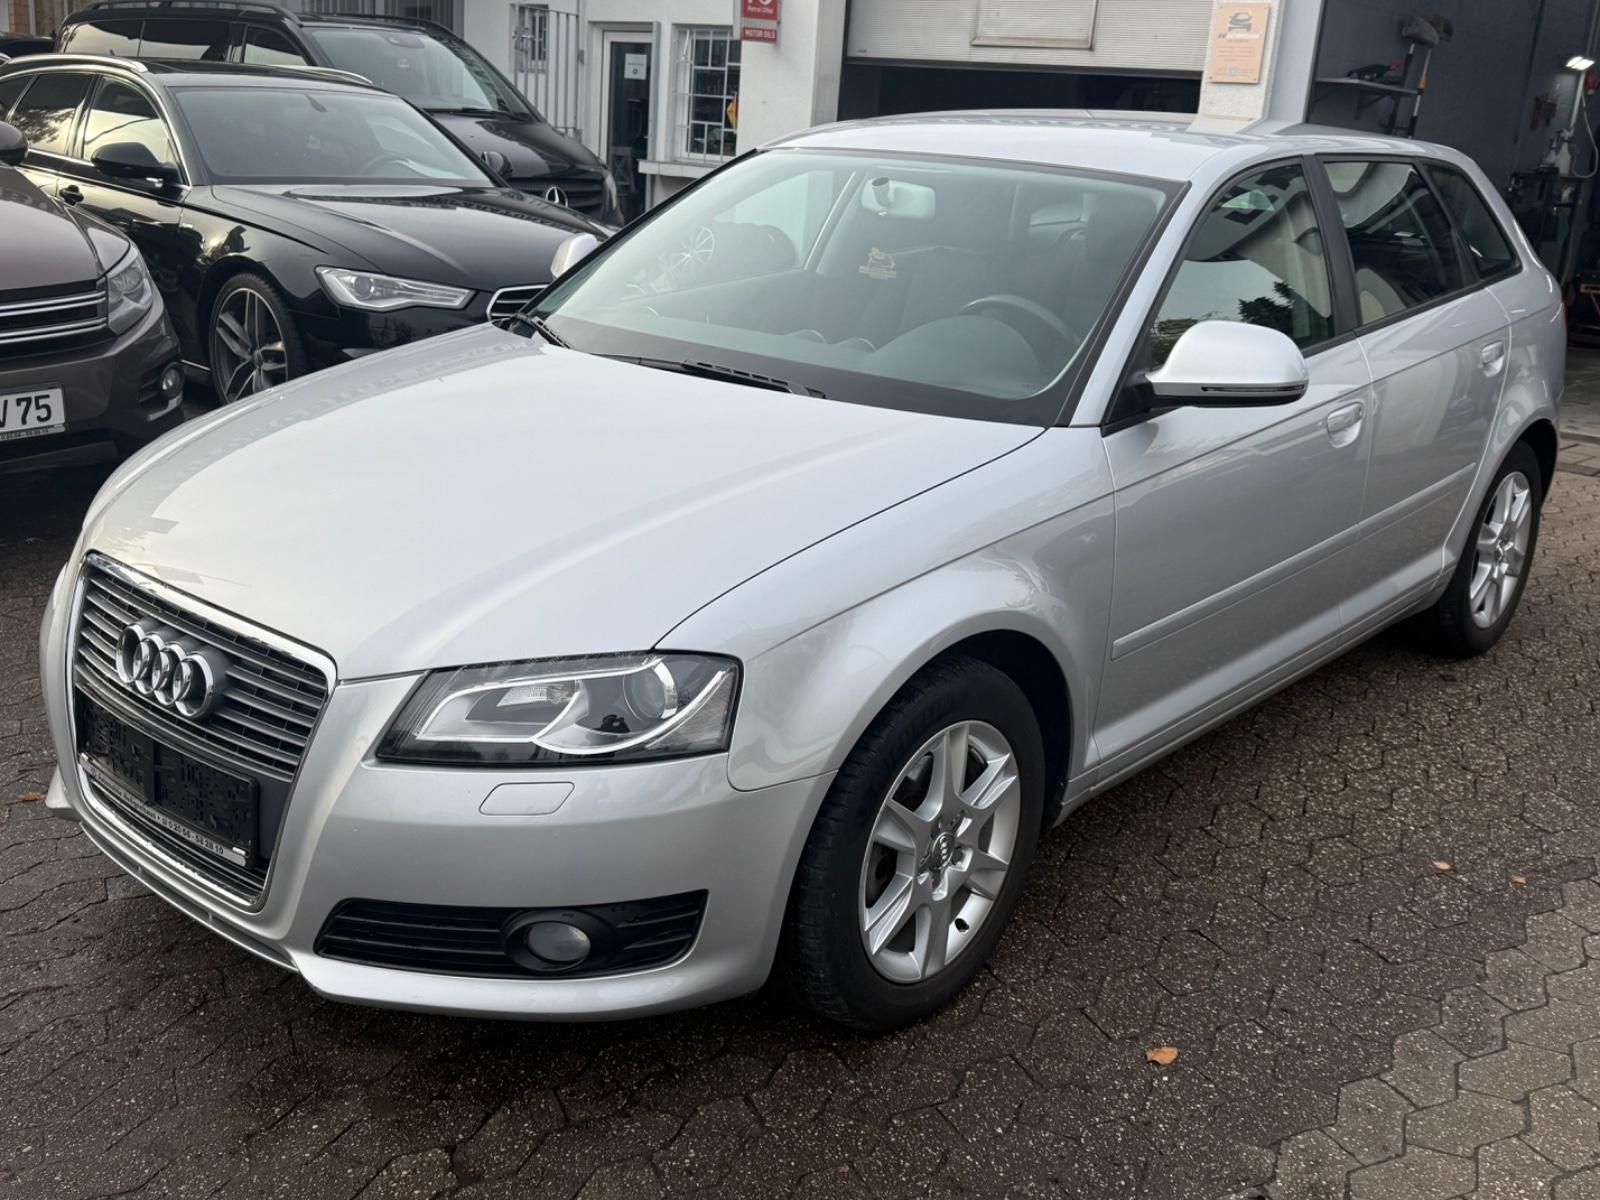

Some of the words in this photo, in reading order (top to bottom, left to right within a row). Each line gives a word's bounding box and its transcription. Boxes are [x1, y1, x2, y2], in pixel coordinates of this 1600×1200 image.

[745, 29, 762, 38] MOTOR
[763, 30, 776, 39] OILS
[16, 394, 52, 426] 75
